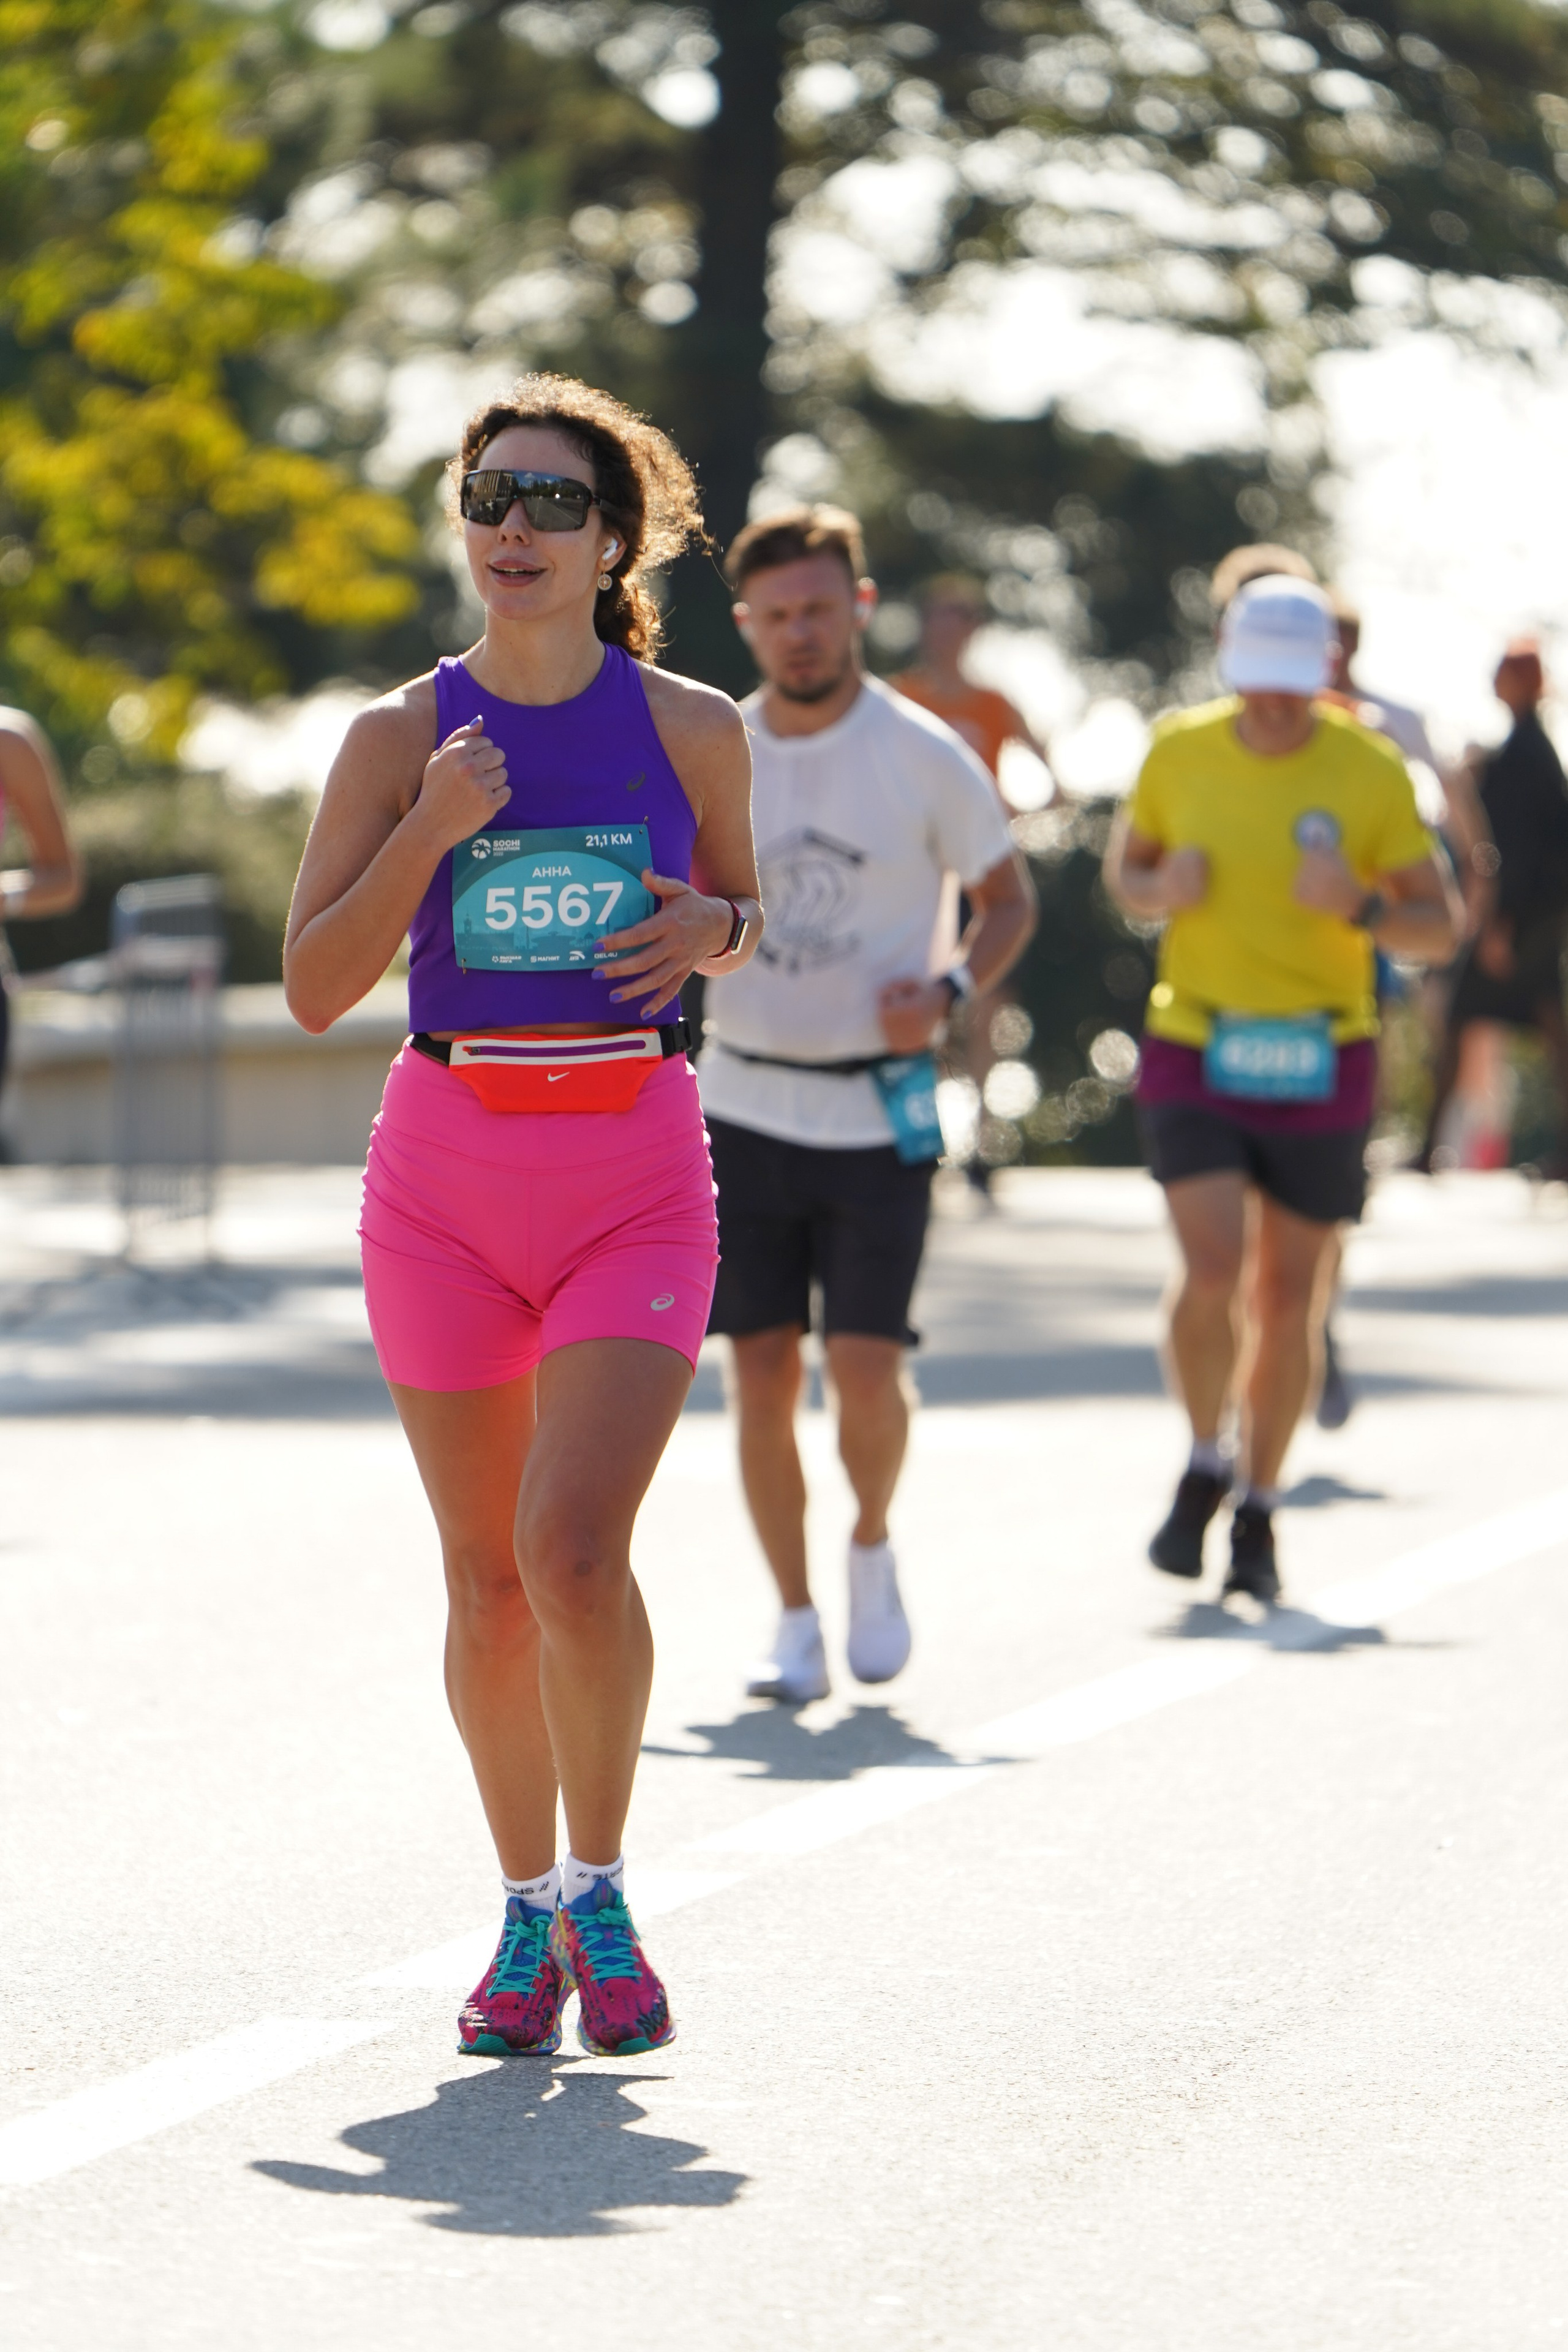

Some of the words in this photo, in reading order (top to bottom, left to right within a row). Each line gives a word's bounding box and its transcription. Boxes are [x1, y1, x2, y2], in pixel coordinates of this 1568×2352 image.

[586, 834, 608, 848] 21,1
[611, 833, 633, 845] KM
[532, 865, 571, 878] АННА
[484, 881, 624, 930] 5567
